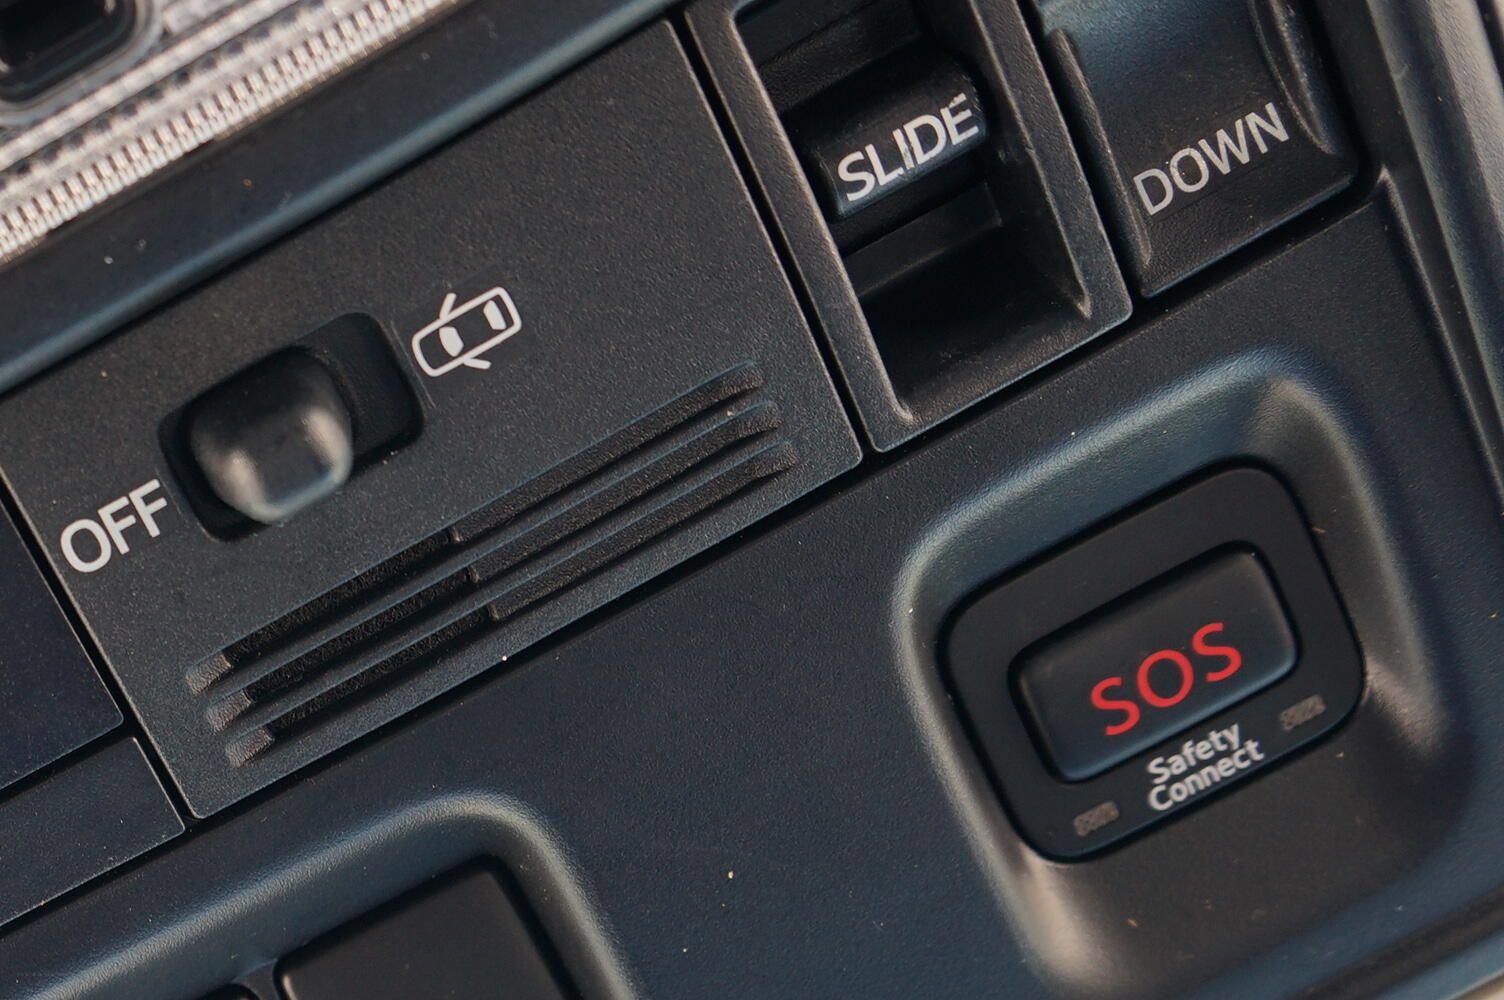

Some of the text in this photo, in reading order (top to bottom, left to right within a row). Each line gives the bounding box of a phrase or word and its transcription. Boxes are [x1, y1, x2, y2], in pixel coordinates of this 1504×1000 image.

[837, 92, 980, 203] SLIDE
[1133, 102, 1289, 216] DOWN
[59, 478, 168, 573] OFF
[1090, 622, 1242, 737] SOS
[1146, 723, 1240, 784] Safety
[1148, 739, 1265, 811] Connect
